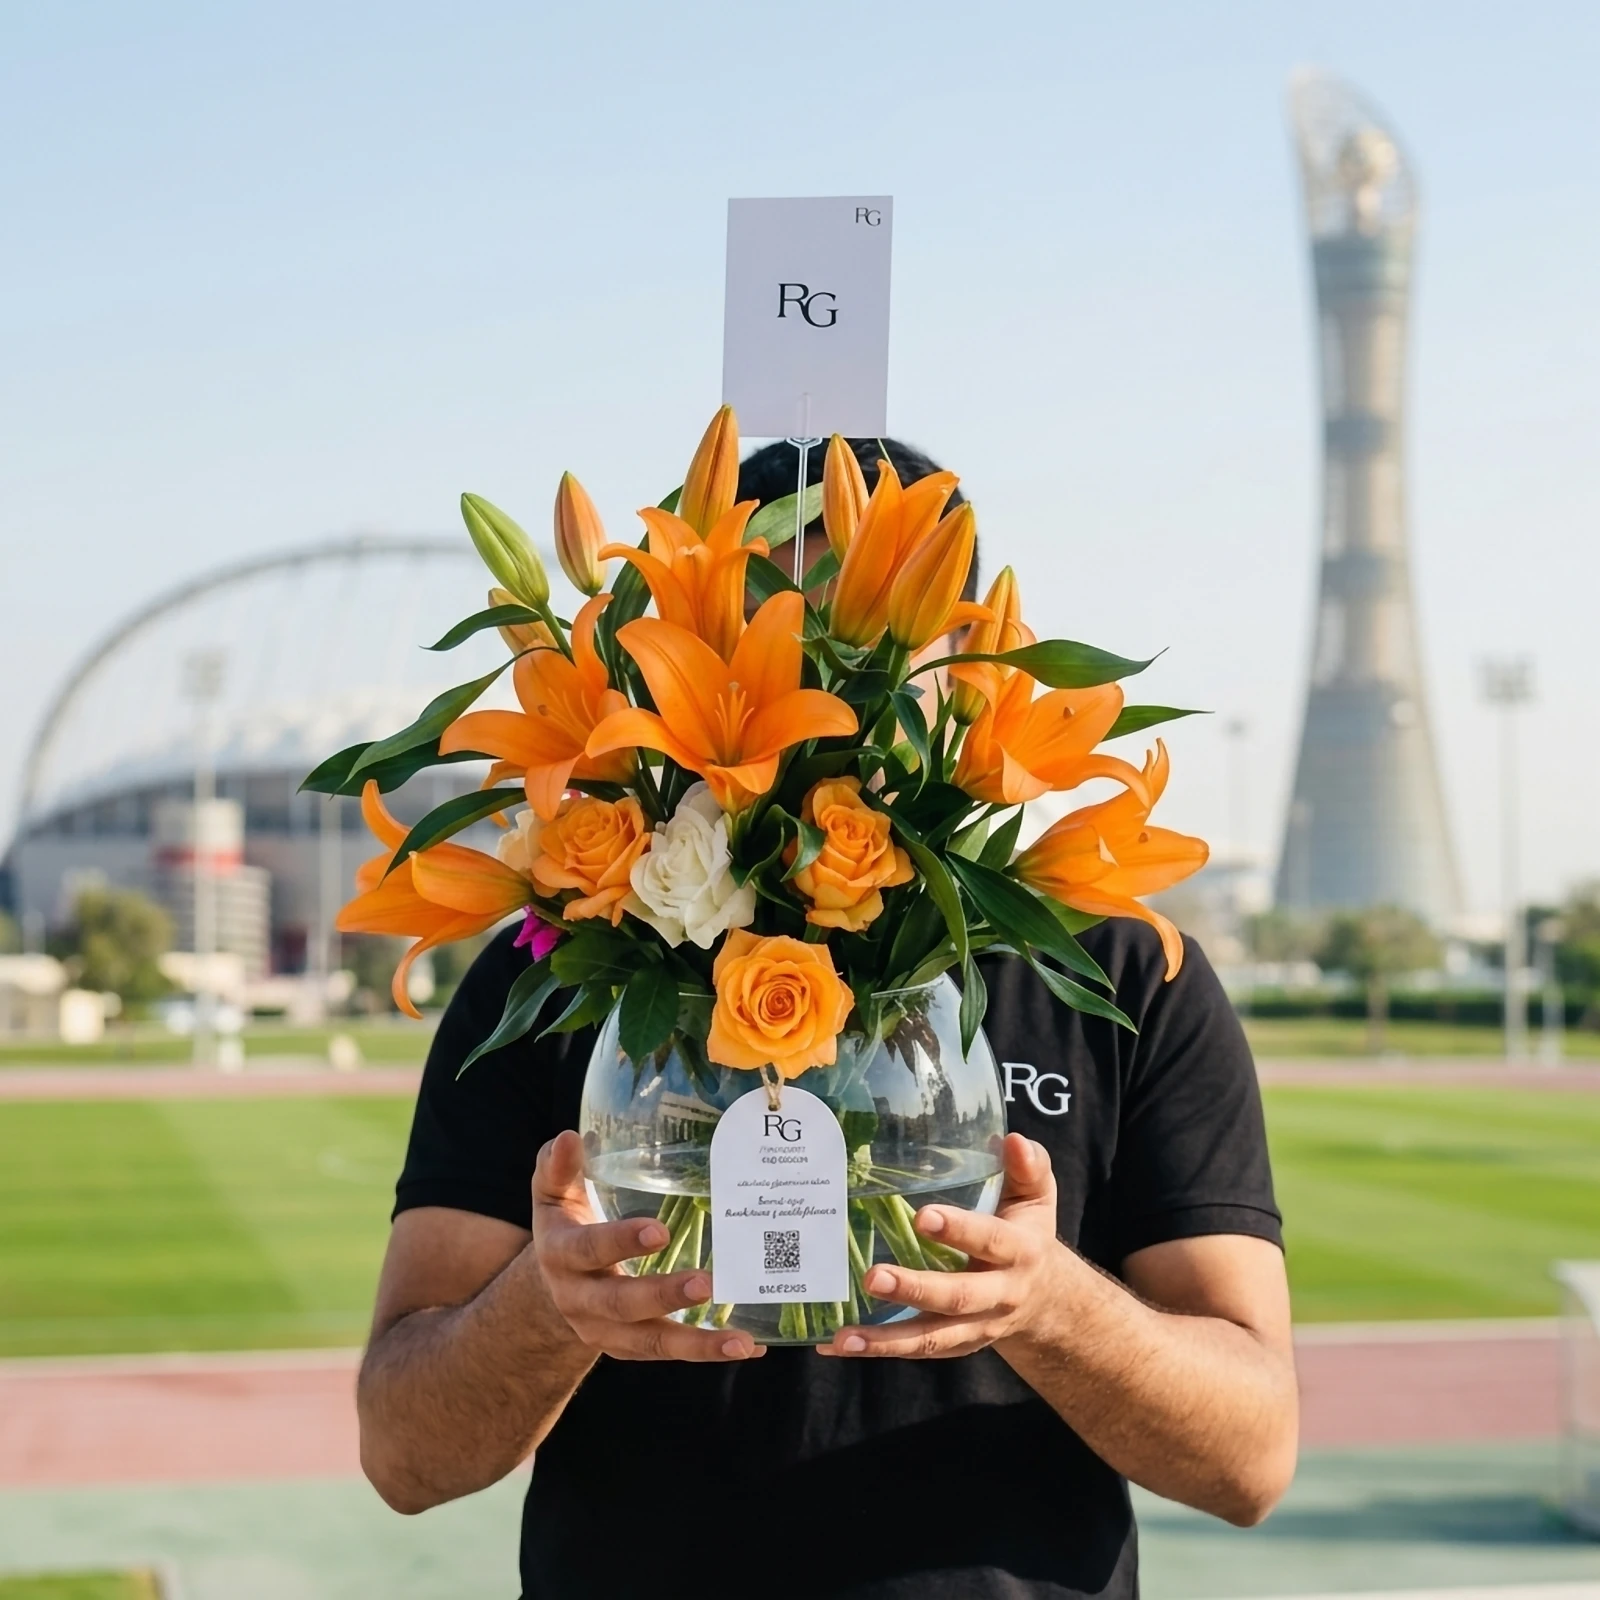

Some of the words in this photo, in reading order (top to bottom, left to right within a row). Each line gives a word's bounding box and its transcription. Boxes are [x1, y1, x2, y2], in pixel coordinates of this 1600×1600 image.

[855, 207, 881, 226] RG
[777, 282, 839, 328] RG
[1001, 1062, 1072, 1115] RG
[763, 1114, 802, 1142] RG
